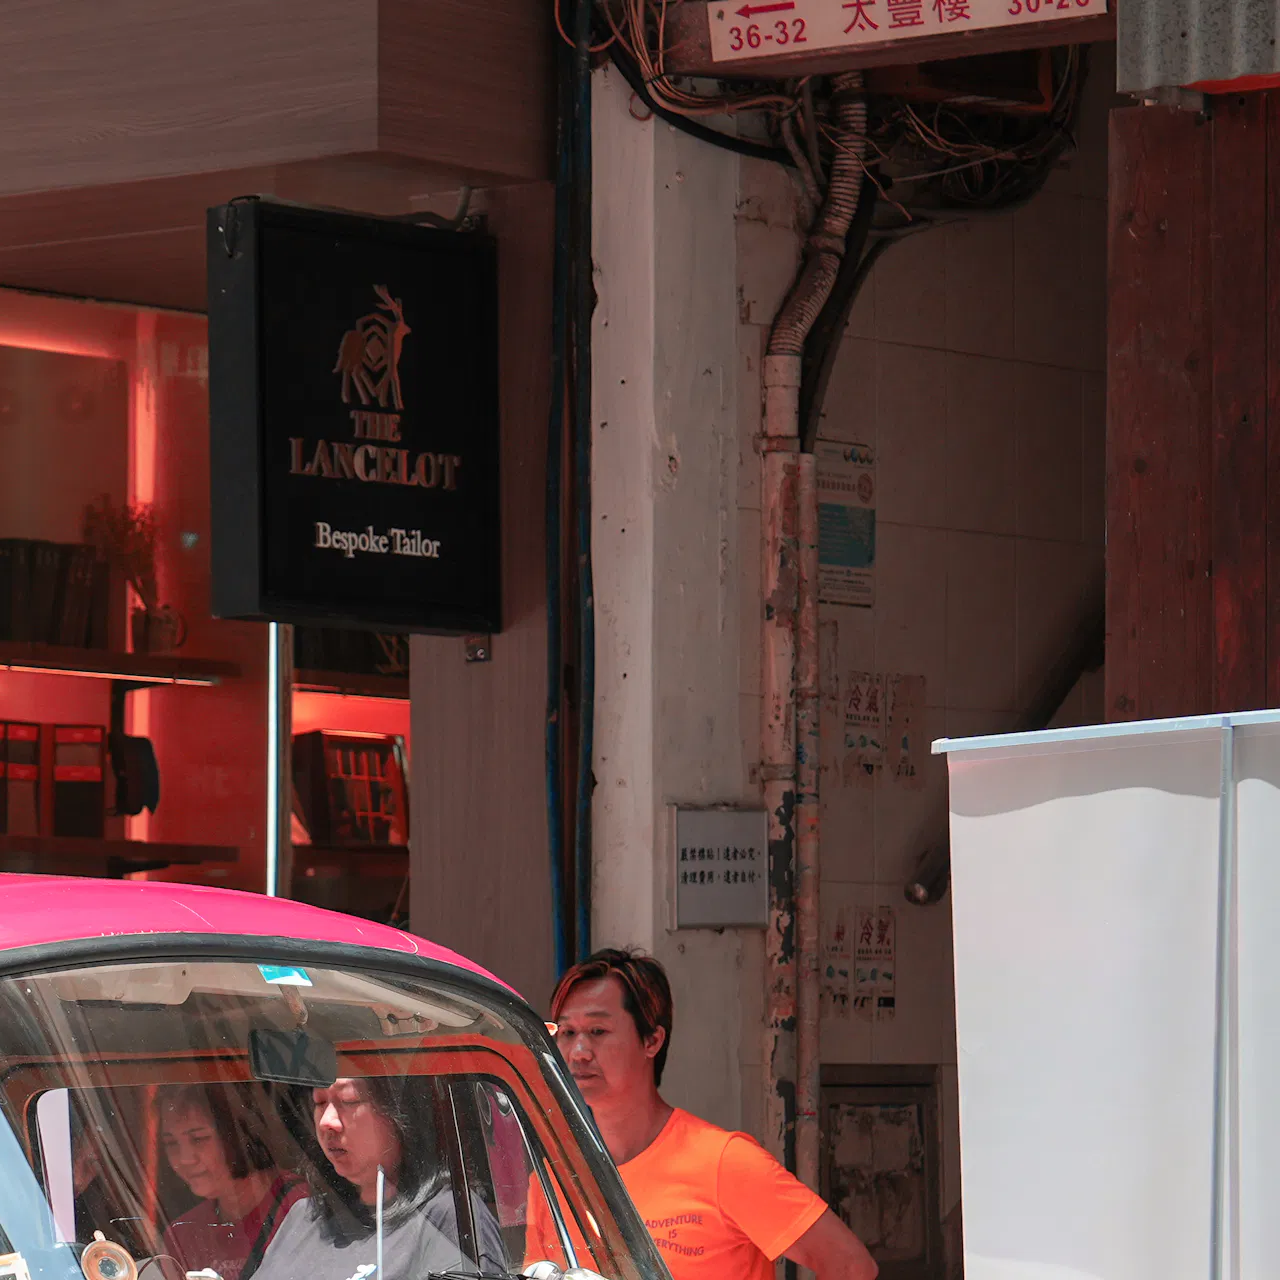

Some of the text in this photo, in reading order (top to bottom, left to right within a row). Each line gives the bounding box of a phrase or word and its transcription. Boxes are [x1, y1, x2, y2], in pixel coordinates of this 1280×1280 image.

[729, 18, 808, 51] 36-32
[1008, 0, 1090, 15] 30-
[350, 410, 402, 443] THE
[289, 437, 461, 490] LANCELOT
[314, 521, 441, 558] Bespoke Tailor
[645, 1214, 703, 1229] ADVENTURE
[668, 1229, 678, 1239] IS
[654, 1238, 705, 1257] ERYTHING
